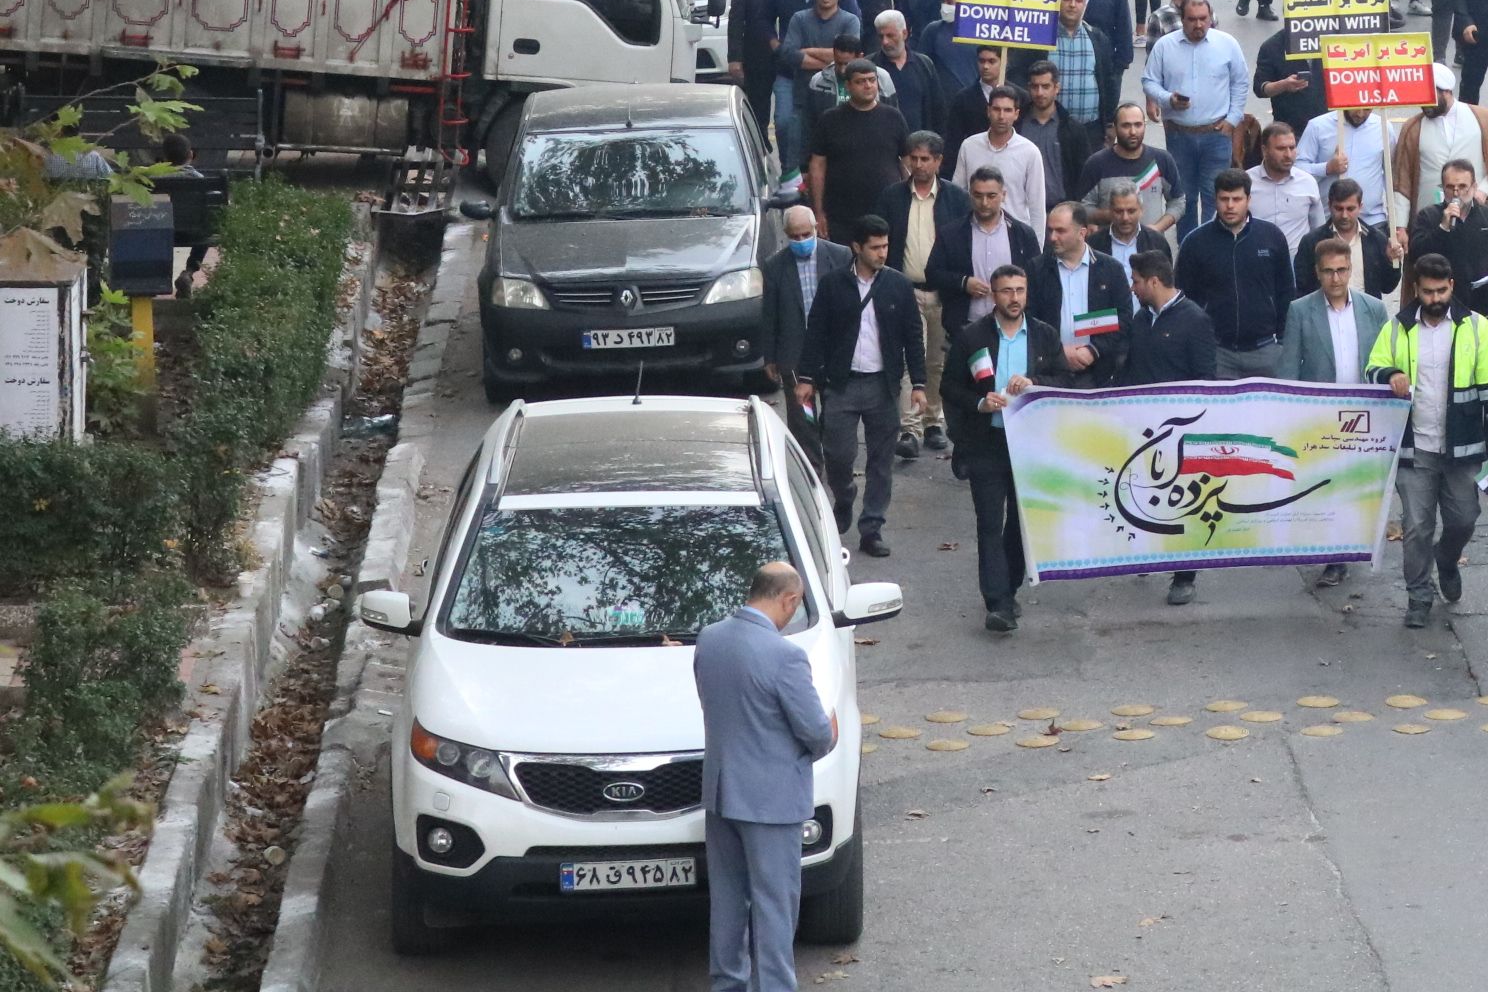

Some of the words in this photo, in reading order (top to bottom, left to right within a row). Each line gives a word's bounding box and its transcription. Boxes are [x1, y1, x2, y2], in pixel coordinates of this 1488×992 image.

[960, 5, 1008, 21] DOWN
[1015, 10, 1049, 24] WITH
[1290, 18, 1339, 32] DOWN
[1345, 16, 1380, 30] WITH
[975, 23, 1031, 42] ISRAEL
[1376, 46, 1390, 60] بر
[1395, 40, 1426, 58] مرگ
[1329, 70, 1381, 85] DOWN
[1387, 68, 1423, 82] WITH
[1359, 89, 1399, 103] U.S.A
[4, 297, 25, 306] دوخت
[26, 296, 50, 306] سفارش
[656, 331, 673, 346] ۸۲
[4, 377, 25, 386] دوخت
[26, 377, 50, 387] سفارش
[1303, 443, 1318, 451] هراز
[610, 784, 638, 797] KIA
[668, 864, 695, 885] ۸۲
